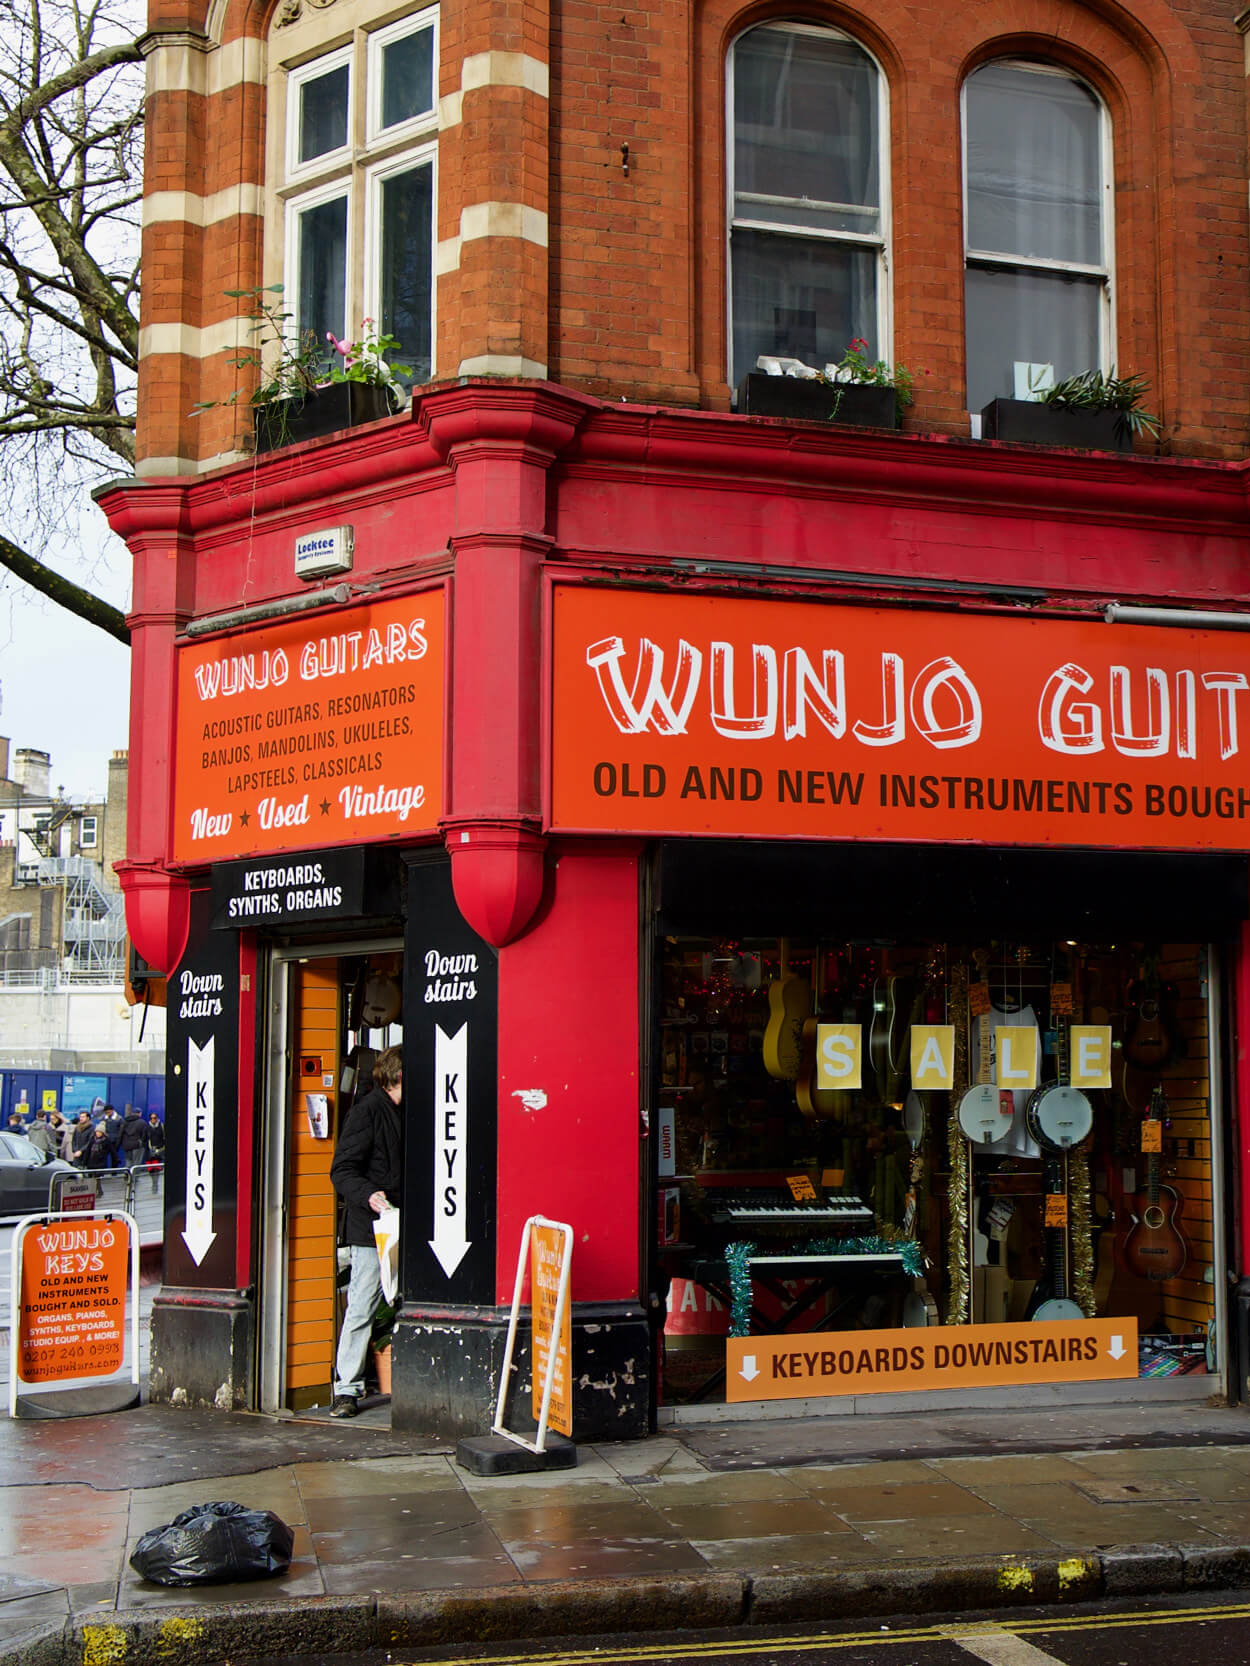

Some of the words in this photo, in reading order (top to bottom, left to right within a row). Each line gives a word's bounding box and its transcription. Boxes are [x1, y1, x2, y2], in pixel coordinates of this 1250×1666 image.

[298, 538, 334, 555] Locktec
[194, 647, 290, 701] WUNJO
[300, 618, 429, 681] GUITARS
[586, 635, 983, 750] WUNJO
[202, 713, 263, 741] ACOUSTIC
[266, 702, 323, 729] GUITARS,
[327, 684, 416, 718] RESONATORS
[202, 744, 254, 769] BANJOS,
[257, 729, 338, 760] MANDOLINS,
[343, 716, 414, 745] UKULELES,
[227, 766, 299, 794] LAPSTEELS,
[303, 751, 383, 782] CLASSICALS
[593, 761, 667, 798] OLD
[680, 764, 763, 802] AND
[777, 769, 866, 806] NEW
[879, 773, 1133, 816] INSTRUMENTS
[190, 807, 232, 841] New
[257, 794, 311, 830] Used
[338, 784, 426, 822] Vintage
[244, 863, 326, 891] KEYBOARDS,
[228, 893, 283, 917] SYNTHS,
[286, 886, 342, 912] ORGANS
[424, 949, 479, 978] Down
[179, 969, 224, 995] Down
[424, 975, 477, 1003] stairs
[179, 996, 223, 1019] stairs
[822, 1034, 1102, 1079] SALE
[193, 1081, 207, 1211] KEYS
[443, 1073, 458, 1217] KEYS
[36, 1228, 115, 1253] WUNJO
[45, 1251, 105, 1276] KEYS
[38, 1286, 110, 1300] INSTRUMENTS
[40, 1277, 60, 1287] OLD
[63, 1275, 84, 1286] AND
[86, 1274, 109, 1284] NEW
[25, 1301, 67, 1313] BOUGHT
[69, 1299, 91, 1310] AND
[92, 1297, 121, 1308] SOLD.
[23, 1336, 53, 1348] STUDIO
[94, 1331, 120, 1341] MORE!
[65, 1319, 115, 1333] KEYBOARDS
[23, 1349, 56, 1363] 0207
[60, 1346, 85, 1359] 240
[771, 1345, 925, 1379] KEYBOARDS
[934, 1336, 1099, 1369] DOWNSTAIRS
